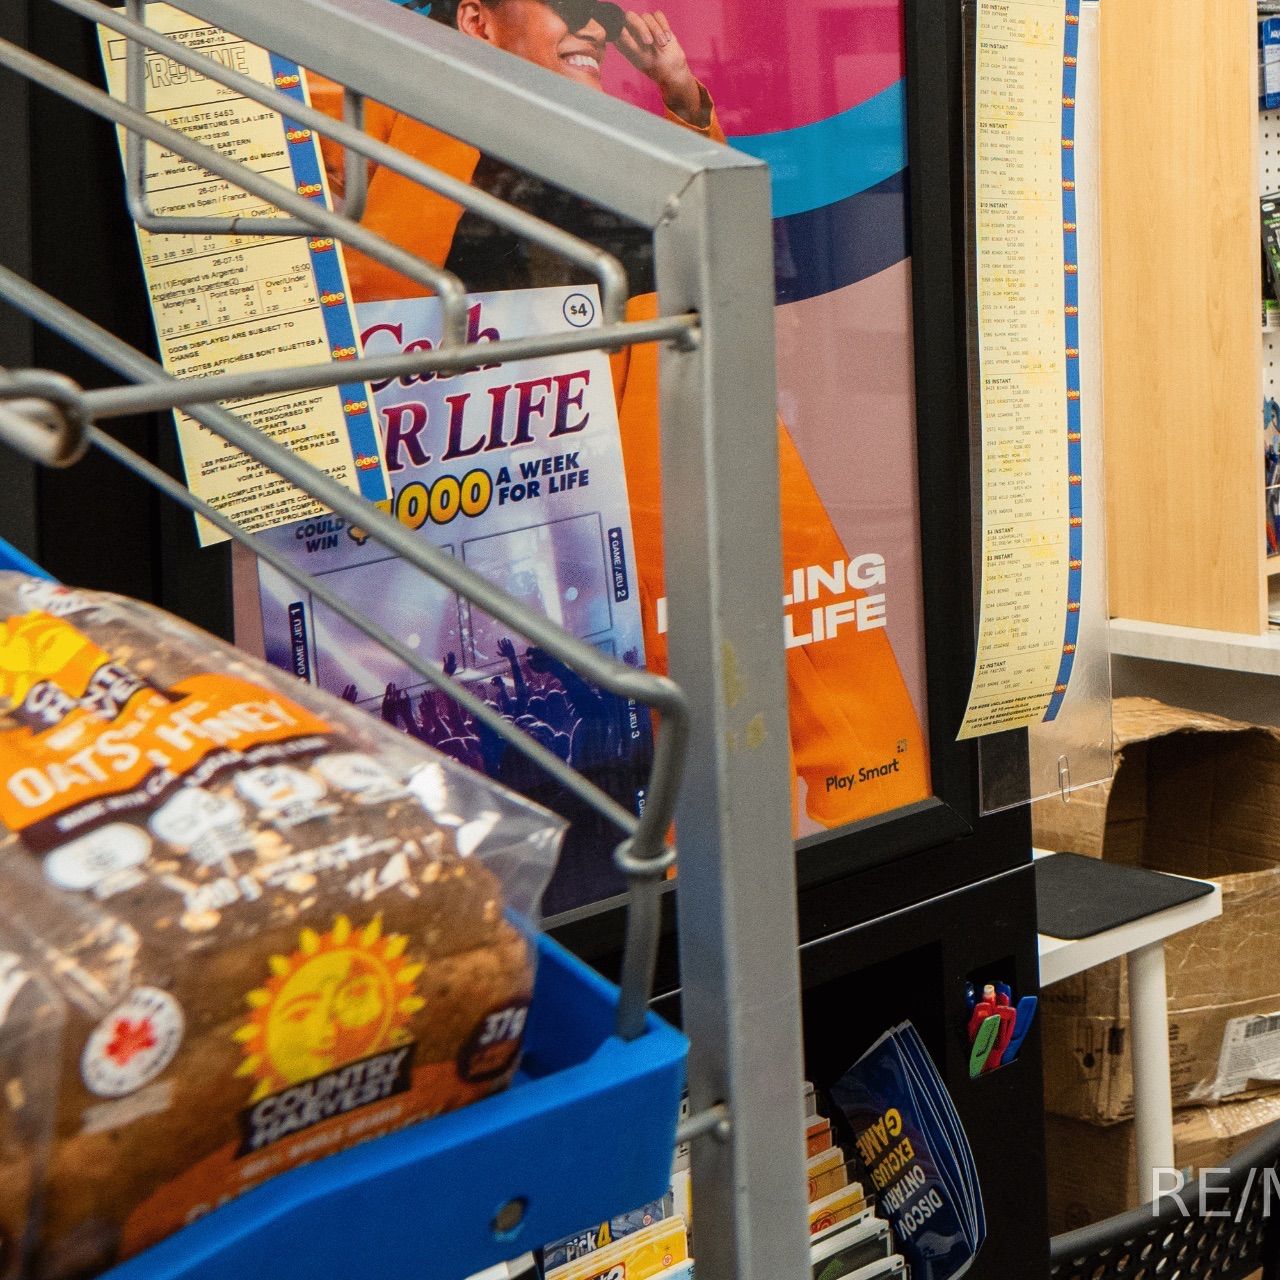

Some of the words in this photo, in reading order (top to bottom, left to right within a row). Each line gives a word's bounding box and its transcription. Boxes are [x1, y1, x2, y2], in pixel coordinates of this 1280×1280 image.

[570, 302, 588, 317] $4
[190, 335, 230, 351] DISPLAYED
[231, 330, 247, 340] ARE
[248, 324, 282, 337] SUBJECT
[170, 351, 200, 362] CHANGE
[441, 370, 590, 462] LIFE
[496, 467, 514, 485] A
[520, 452, 580, 478] WEEK
[498, 478, 540, 506] FOR
[549, 470, 589, 494] LIFE
[306, 534, 339, 553] WIN
[611, 540, 622, 566] GAME
[784, 593, 887, 650] LIFE
[825, 775, 854, 792] Play
[858, 758, 899, 783] Smart
[856, 1107, 903, 1167] GAME
